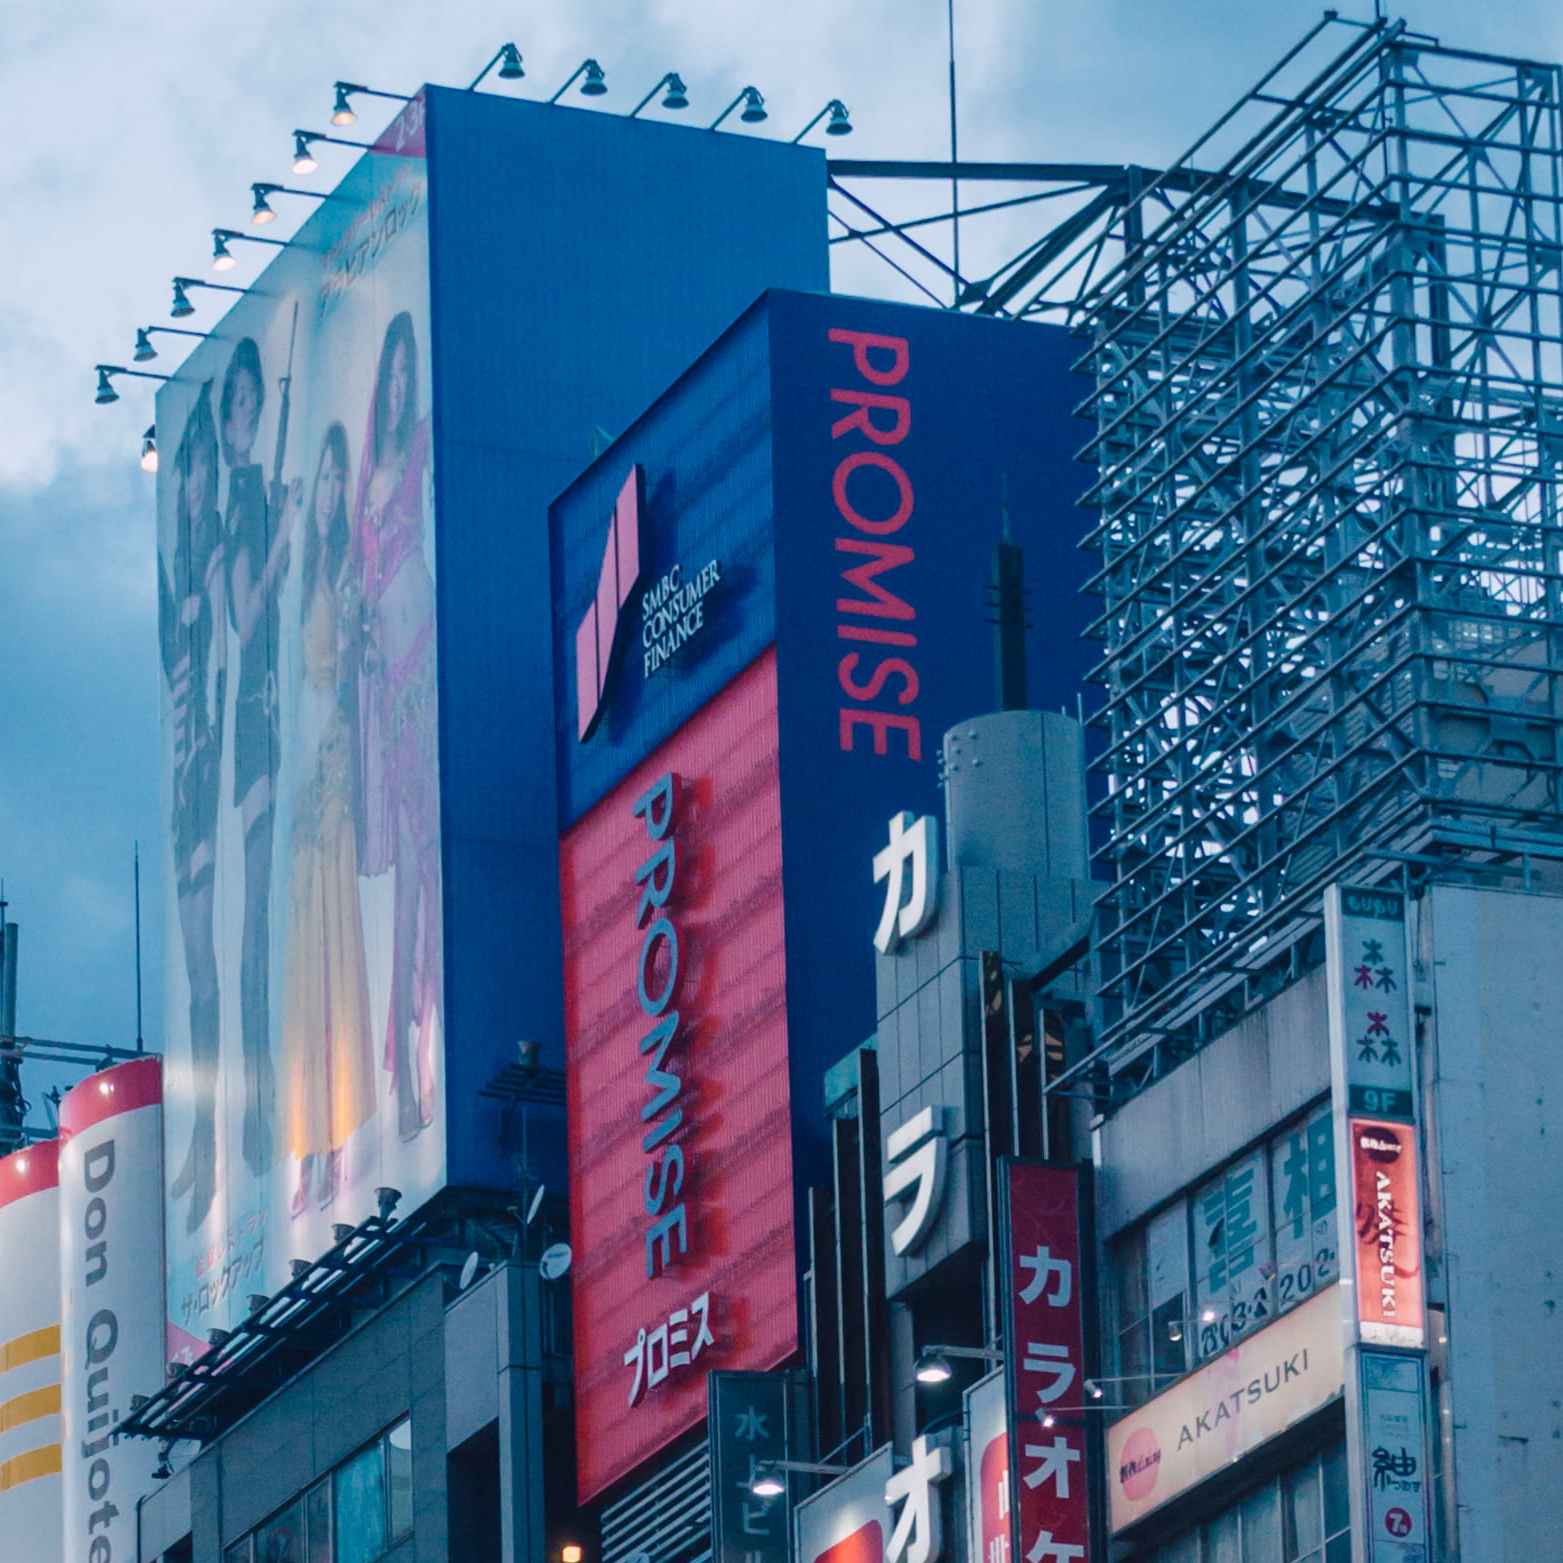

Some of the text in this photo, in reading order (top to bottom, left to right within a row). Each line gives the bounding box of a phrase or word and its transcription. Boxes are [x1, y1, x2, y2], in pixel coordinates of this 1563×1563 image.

[642, 564, 680, 620] SMBC
[828, 327, 921, 761] PROMISE
[642, 559, 721, 649] CONSUMER
[643, 601, 704, 678] FINANCE
[634, 772, 688, 1279] PROMISE
[1364, 1091, 1396, 1112] 9F
[84, 1139, 116, 1286] Don
[1375, 1171, 1396, 1319] AKATSUKI
[624, 1291, 715, 1408] プロミス
[1177, 1349, 1309, 1450] AKATSUKI
